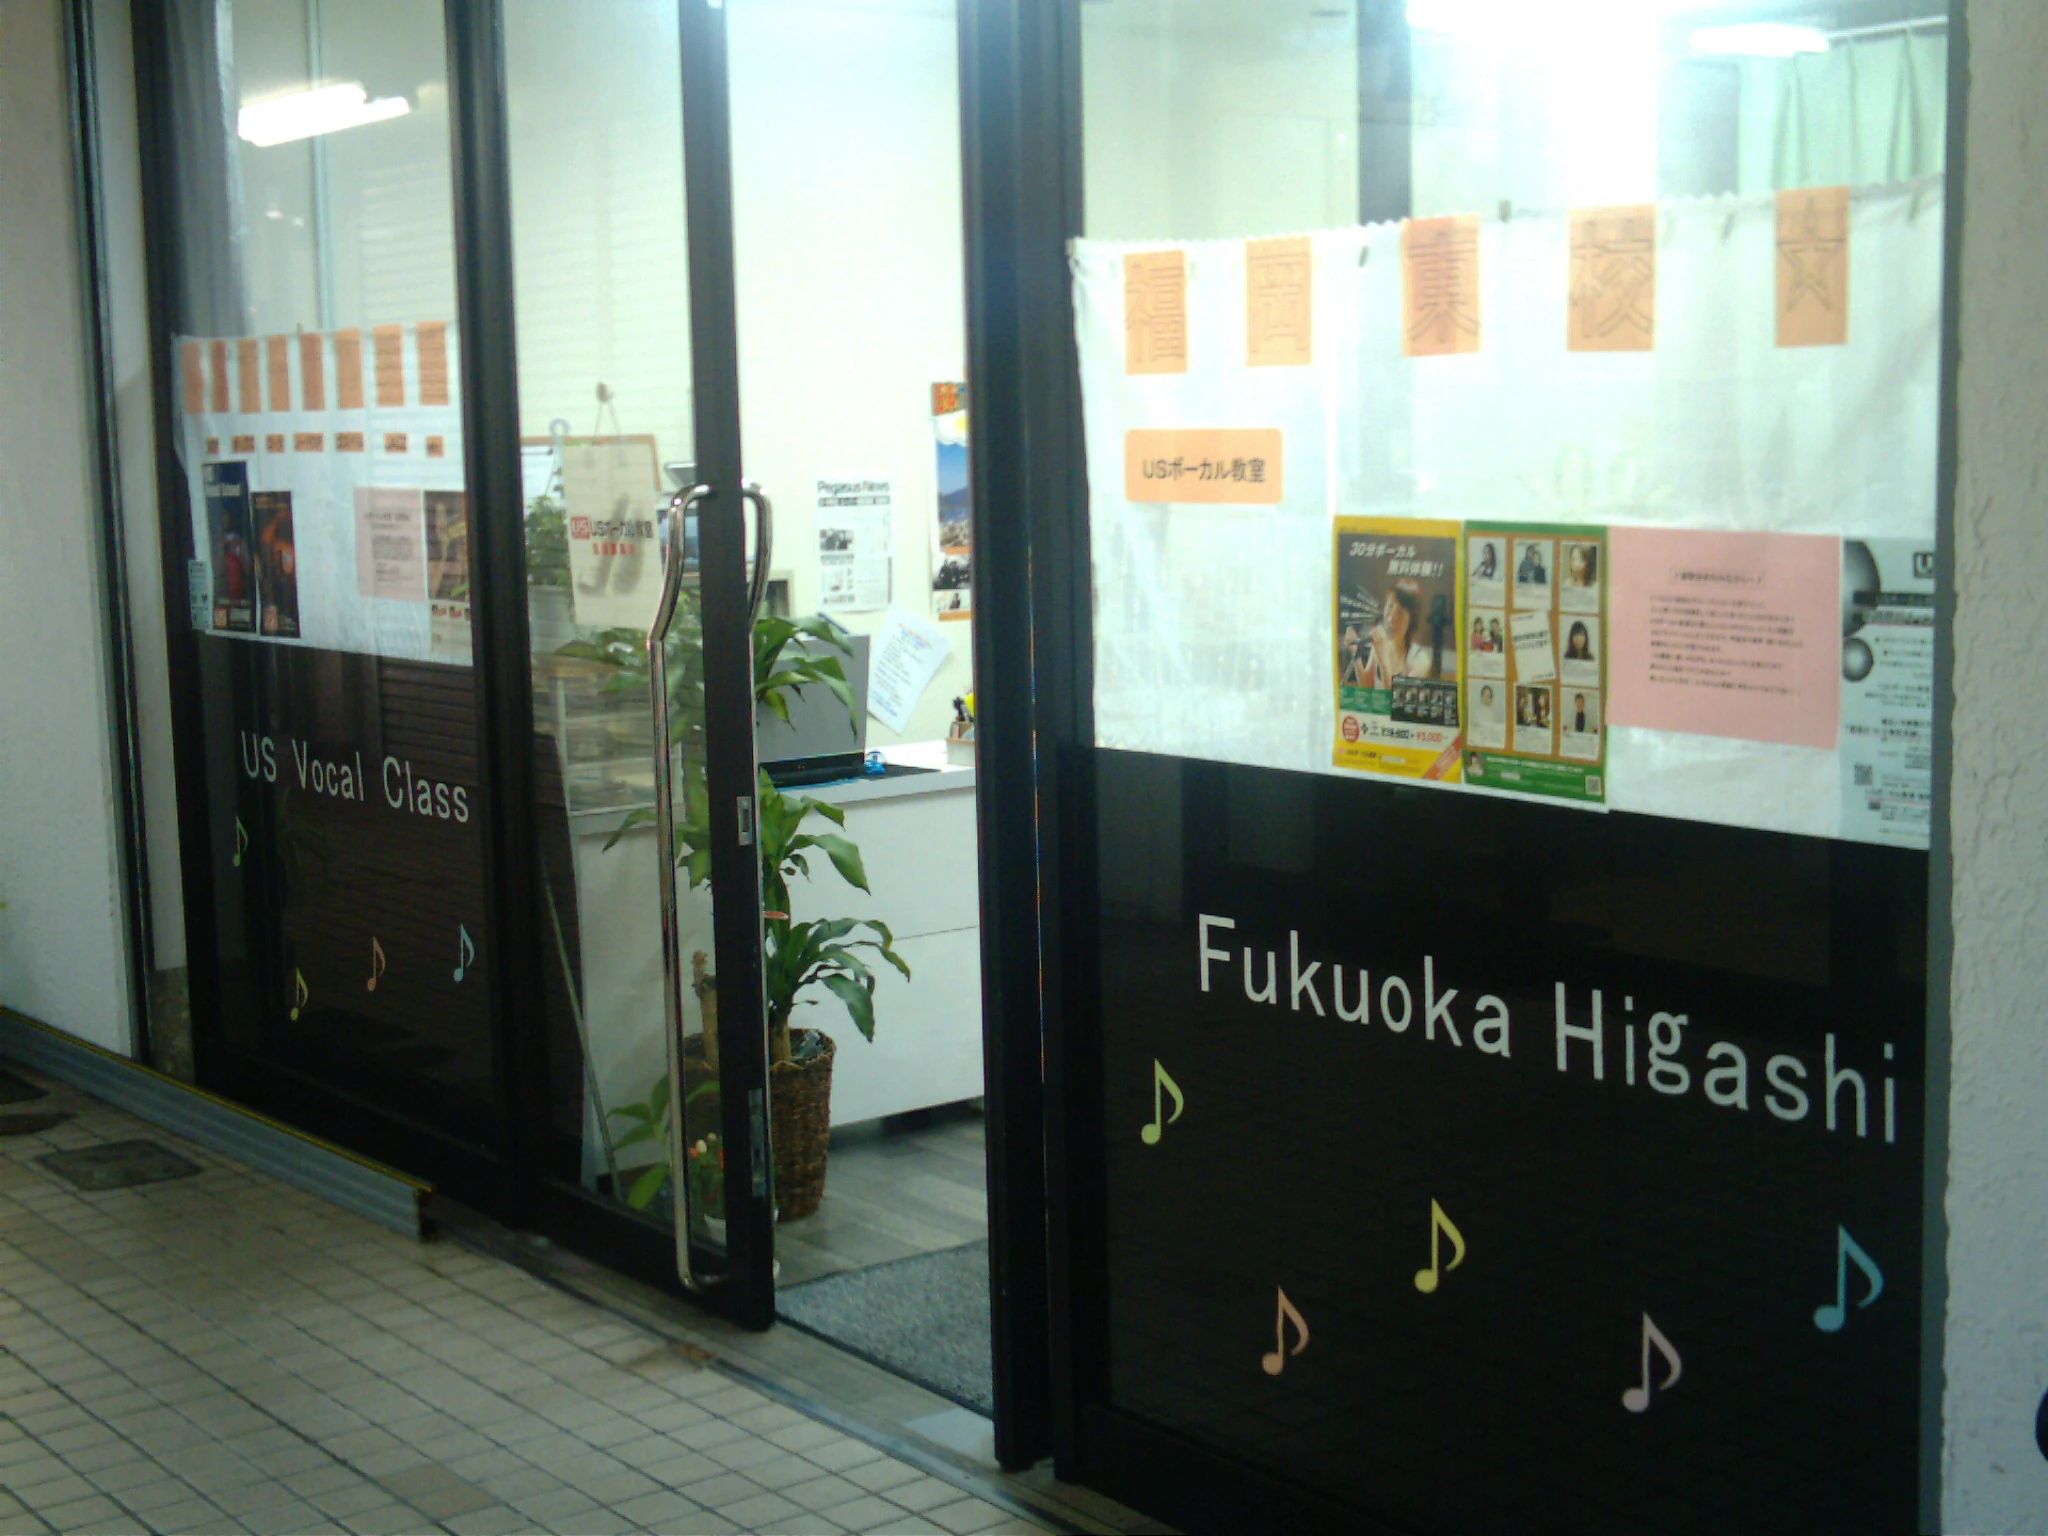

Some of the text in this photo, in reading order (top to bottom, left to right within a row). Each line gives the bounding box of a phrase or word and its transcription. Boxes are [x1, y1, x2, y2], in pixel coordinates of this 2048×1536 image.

[1142, 457, 1266, 483] USボーカル教室
[241, 730, 469, 823] US Vocal Class
[1198, 912, 1895, 1144] Fukuoka Higashi
